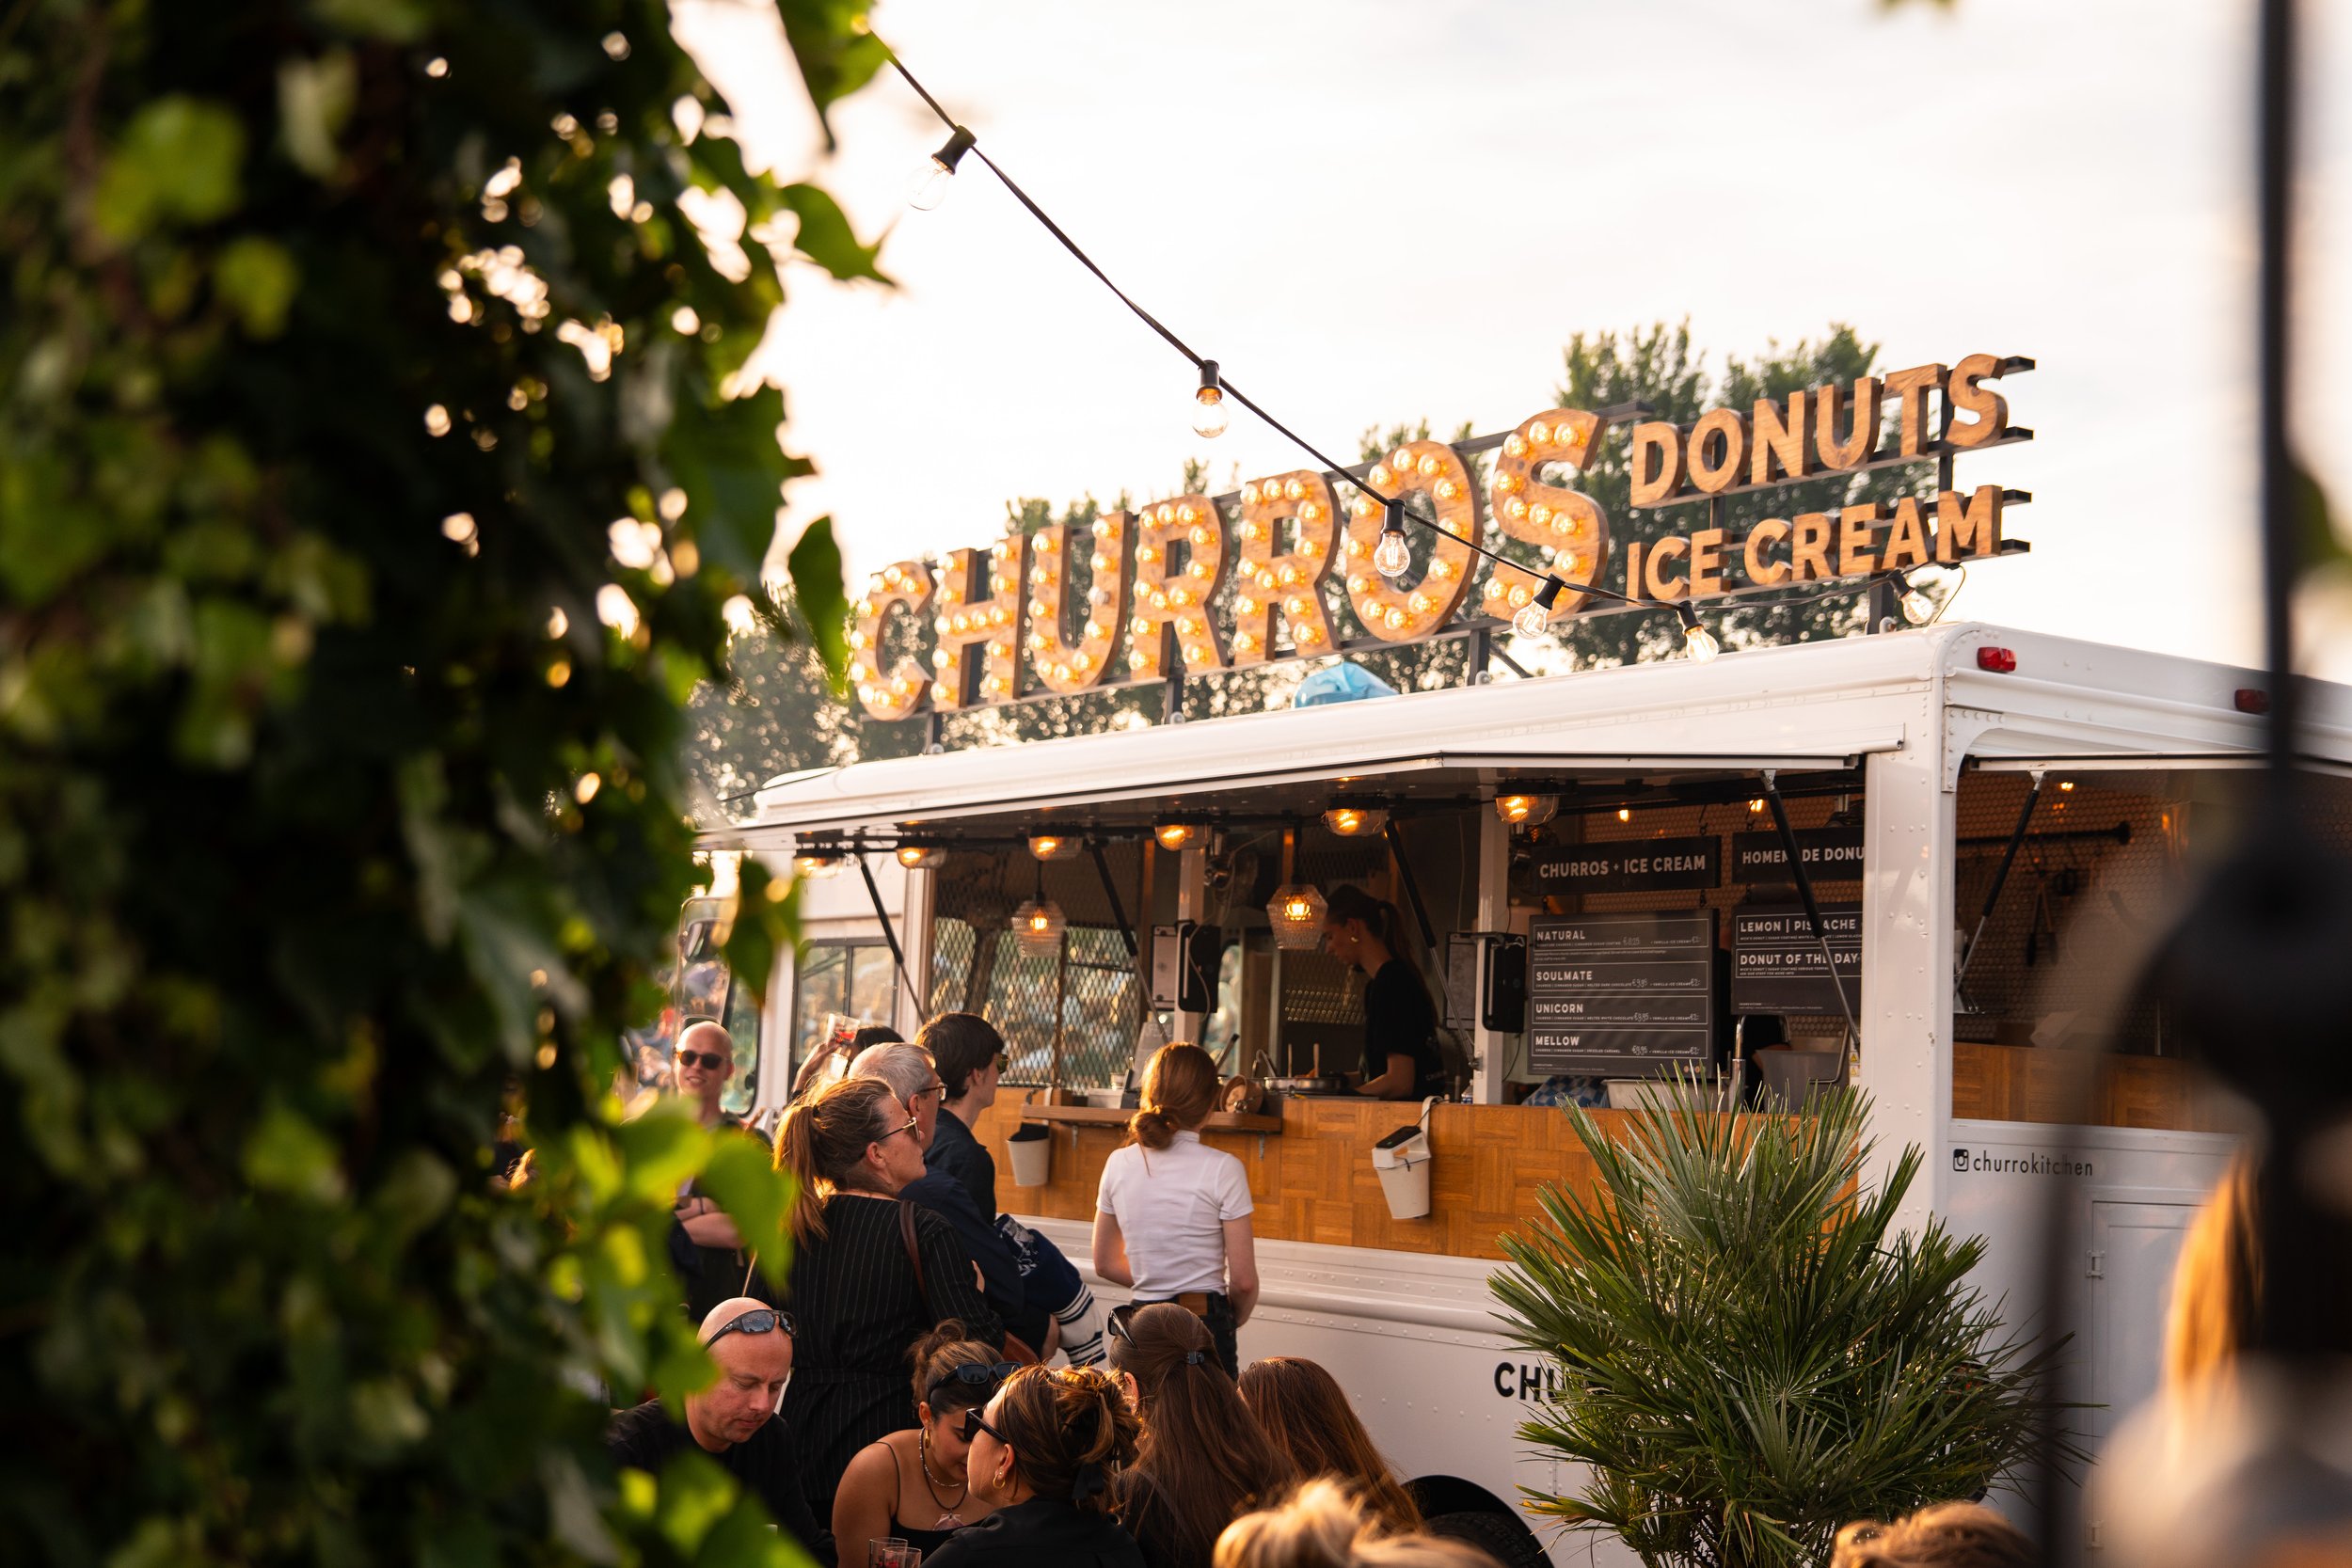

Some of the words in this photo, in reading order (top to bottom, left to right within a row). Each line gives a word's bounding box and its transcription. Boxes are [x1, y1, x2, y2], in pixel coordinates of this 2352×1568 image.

[1630, 354, 2009, 509] DONUTS
[1626, 528, 1733, 608] ICE
[1744, 485, 2003, 587] CREAM
[850, 408, 1610, 721] CHURROS
[1824, 847, 1865, 862] DONU
[1539, 860, 1610, 879] CHURROS
[1624, 858, 1648, 874] ICE
[1653, 855, 1706, 873] CREAM
[1740, 921, 1781, 932] LEMON
[1794, 919, 1856, 931] PISACHE
[1536, 930, 1586, 942] NATURAL
[1740, 954, 1782, 965] DONUT
[1786, 954, 1802, 964] OF
[1835, 953, 1859, 964] DAY
[1535, 971, 1593, 981] SOULMATE
[1535, 1004, 1583, 1014] UNICORN
[1535, 1036, 1580, 1046] MELLOW
[1973, 1150, 2093, 1176] churrokitchen
[1494, 1362, 1565, 1404] CHU
